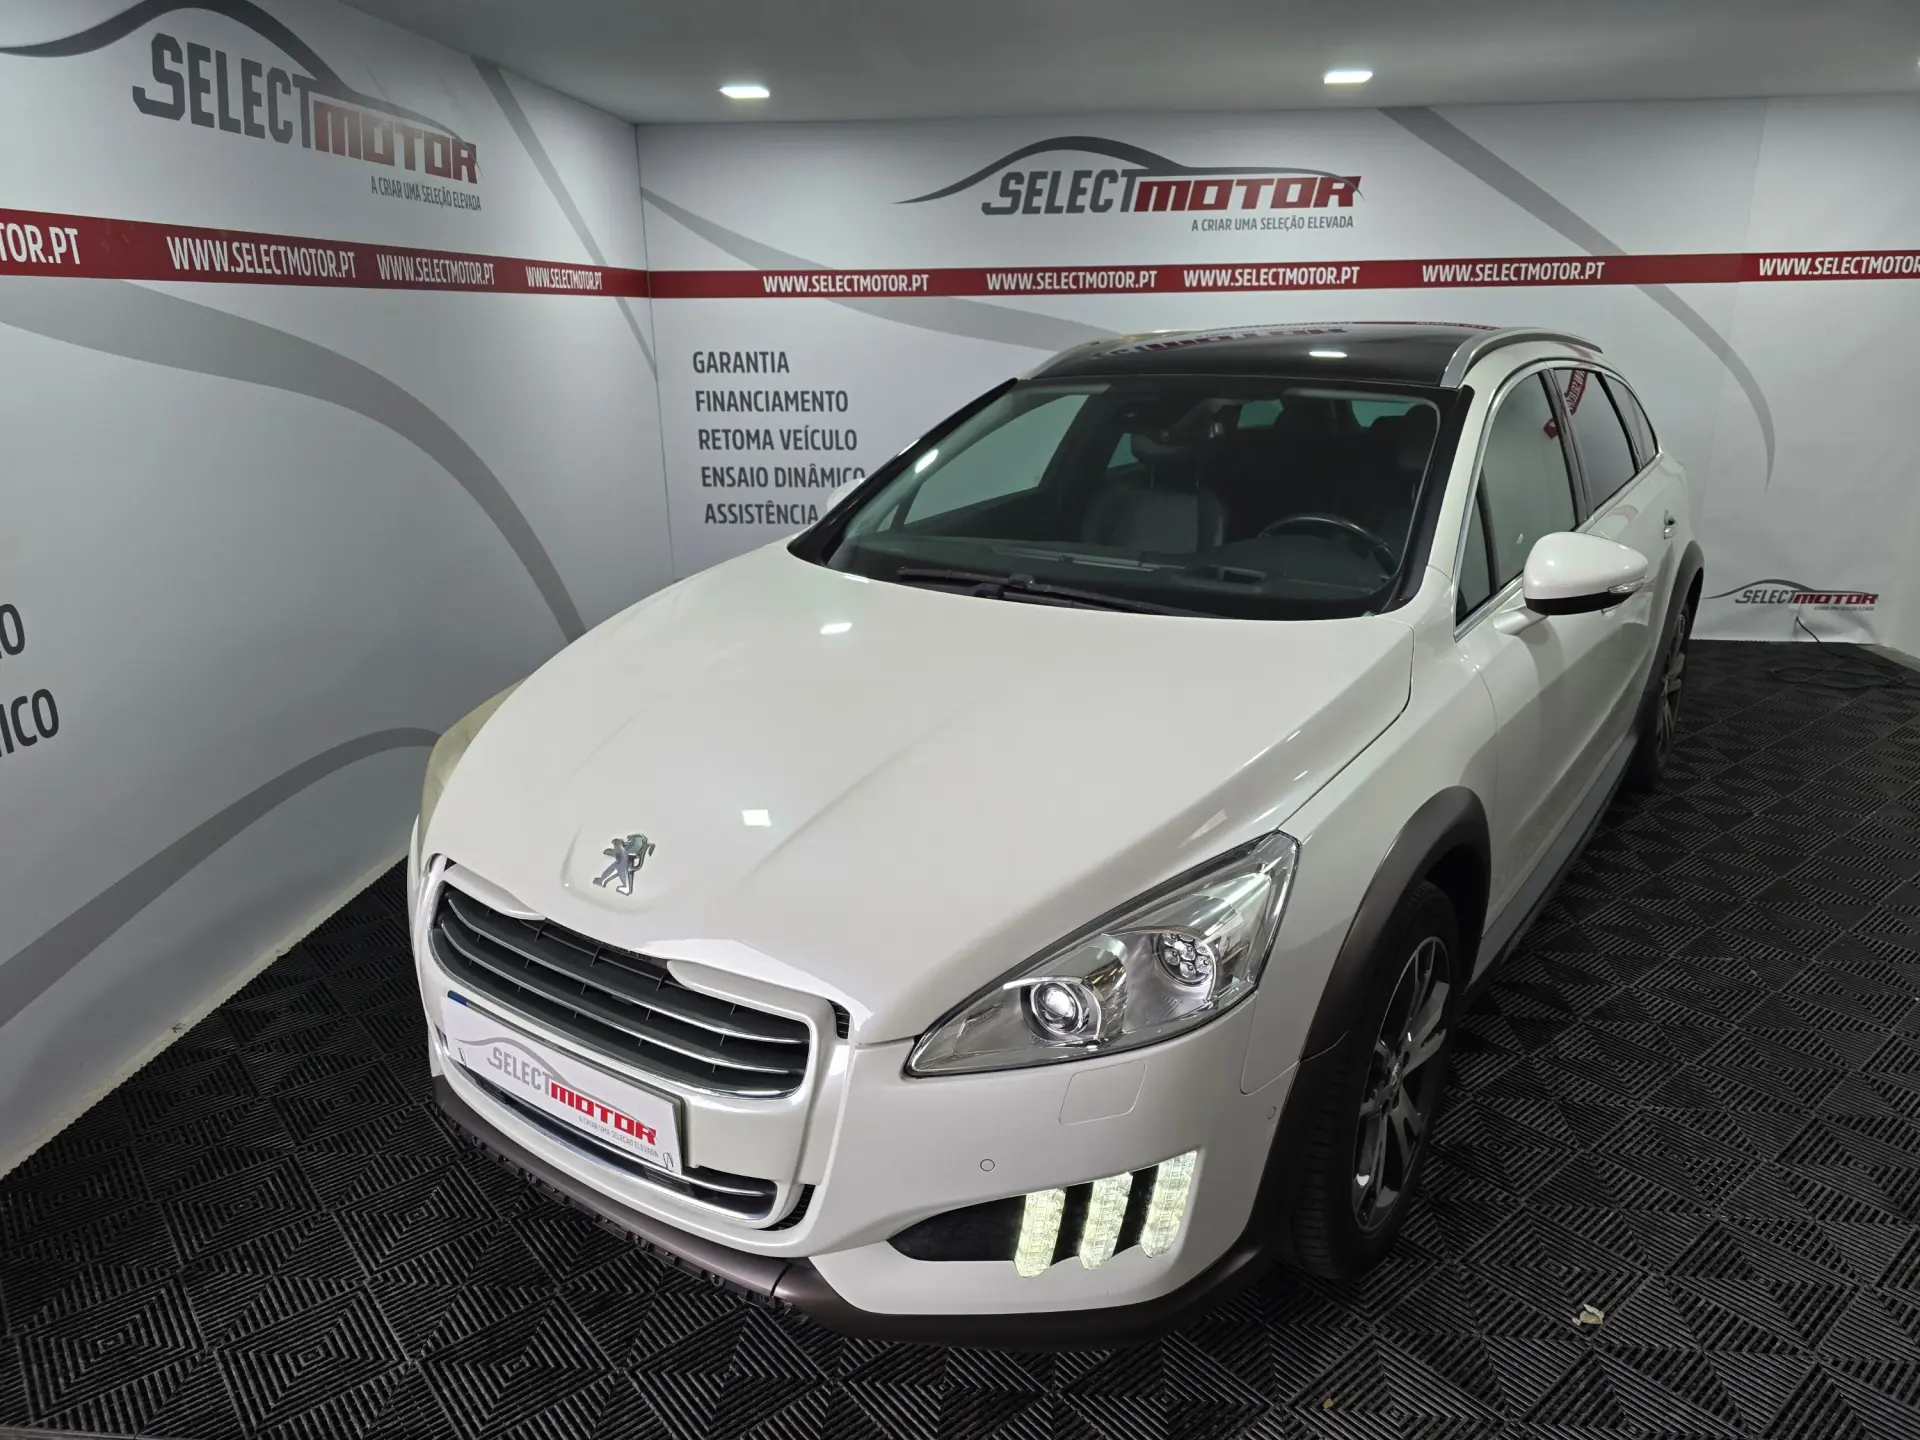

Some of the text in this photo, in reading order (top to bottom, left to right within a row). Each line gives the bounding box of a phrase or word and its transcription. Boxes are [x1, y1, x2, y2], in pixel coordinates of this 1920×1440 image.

[371, 175, 482, 211] A CRIAR UMA SELEÇÃO ELEVADA
[1191, 215, 1354, 232] A CRIAR UMA SELEÇÃO ELEVADA
[166, 236, 356, 279] WWW.SELECTMOTOR.PT
[376, 253, 495, 285] WWW.SELECTMOTOR.PT
[525, 266, 602, 290] WWW.SELECTMOTOR.PT
[1183, 265, 1360, 287] WWW.SELECTMOTOR.PT
[1422, 261, 1605, 283] WWW.SELECTMOTOR.PT
[763, 274, 929, 293] WWW.SELECTMOTOR.PT
[986, 270, 1157, 291] WWW.SELECTMOTOR.PT
[693, 351, 790, 373] GARANTIA
[695, 390, 848, 412] FINANCIAMENTO
[698, 425, 858, 450] RETOMA VEÍCULO
[701, 466, 769, 488] ENSAIO
[704, 500, 819, 525] ASSISTÊNCIA
